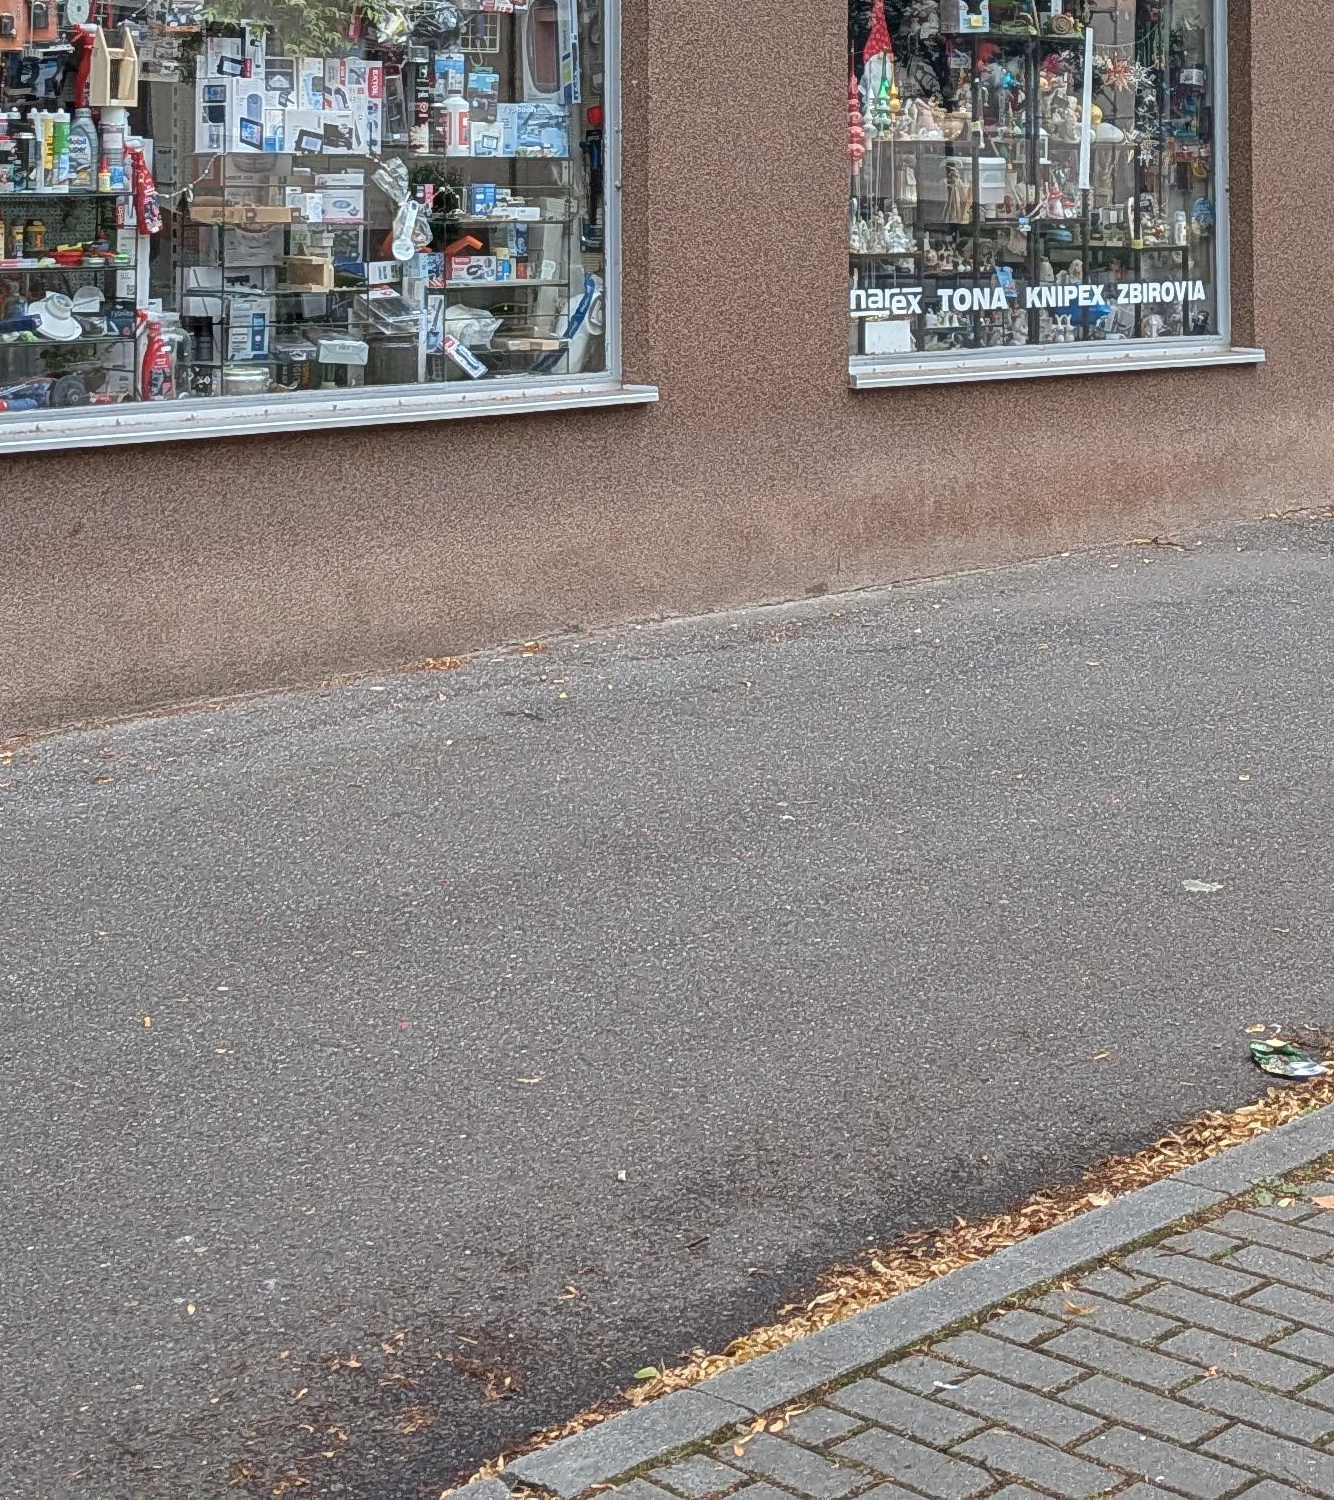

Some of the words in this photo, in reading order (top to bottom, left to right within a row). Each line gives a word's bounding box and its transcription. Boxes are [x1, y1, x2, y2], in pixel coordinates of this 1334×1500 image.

[849, 287, 923, 316] narex
[937, 287, 1008, 312] TONA
[1026, 283, 1105, 309] KNIPEX
[1117, 280, 1206, 305] ZBIROVIA
